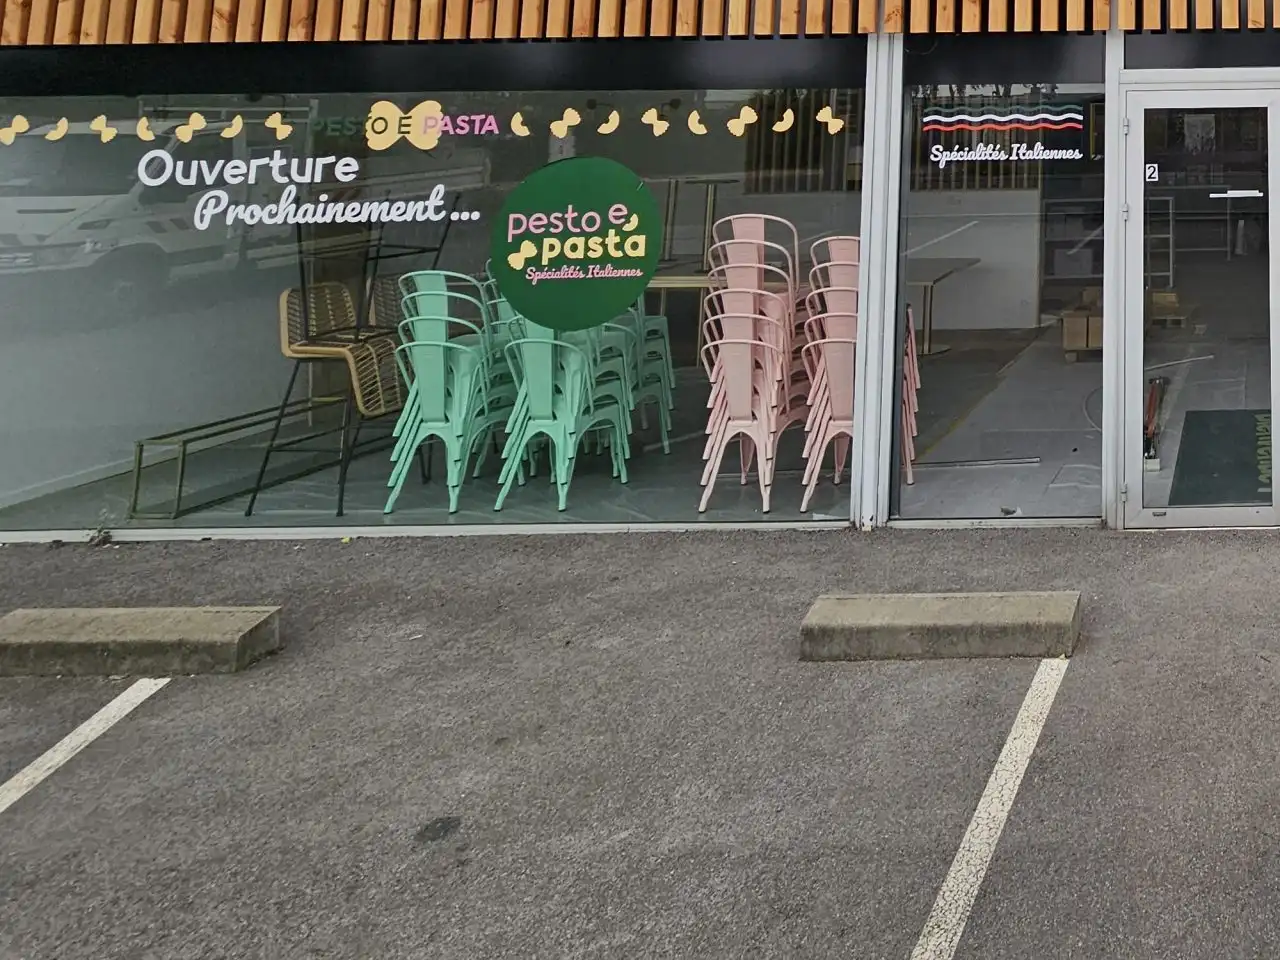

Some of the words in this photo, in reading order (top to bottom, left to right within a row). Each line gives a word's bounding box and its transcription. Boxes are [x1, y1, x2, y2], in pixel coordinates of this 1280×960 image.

[397, 115, 412, 135] E
[423, 114, 500, 136] PASTA
[137, 148, 360, 187] Ouverture
[929, 142, 1008, 168] Spécialités
[1009, 141, 1084, 161] Italiennes
[1147, 165, 1157, 179] 2
[507, 204, 601, 242] pesto
[608, 203, 628, 224] e
[541, 228, 647, 265] pasta
[525, 265, 584, 285] Spécialités
[585, 263, 643, 279] Italiennes
